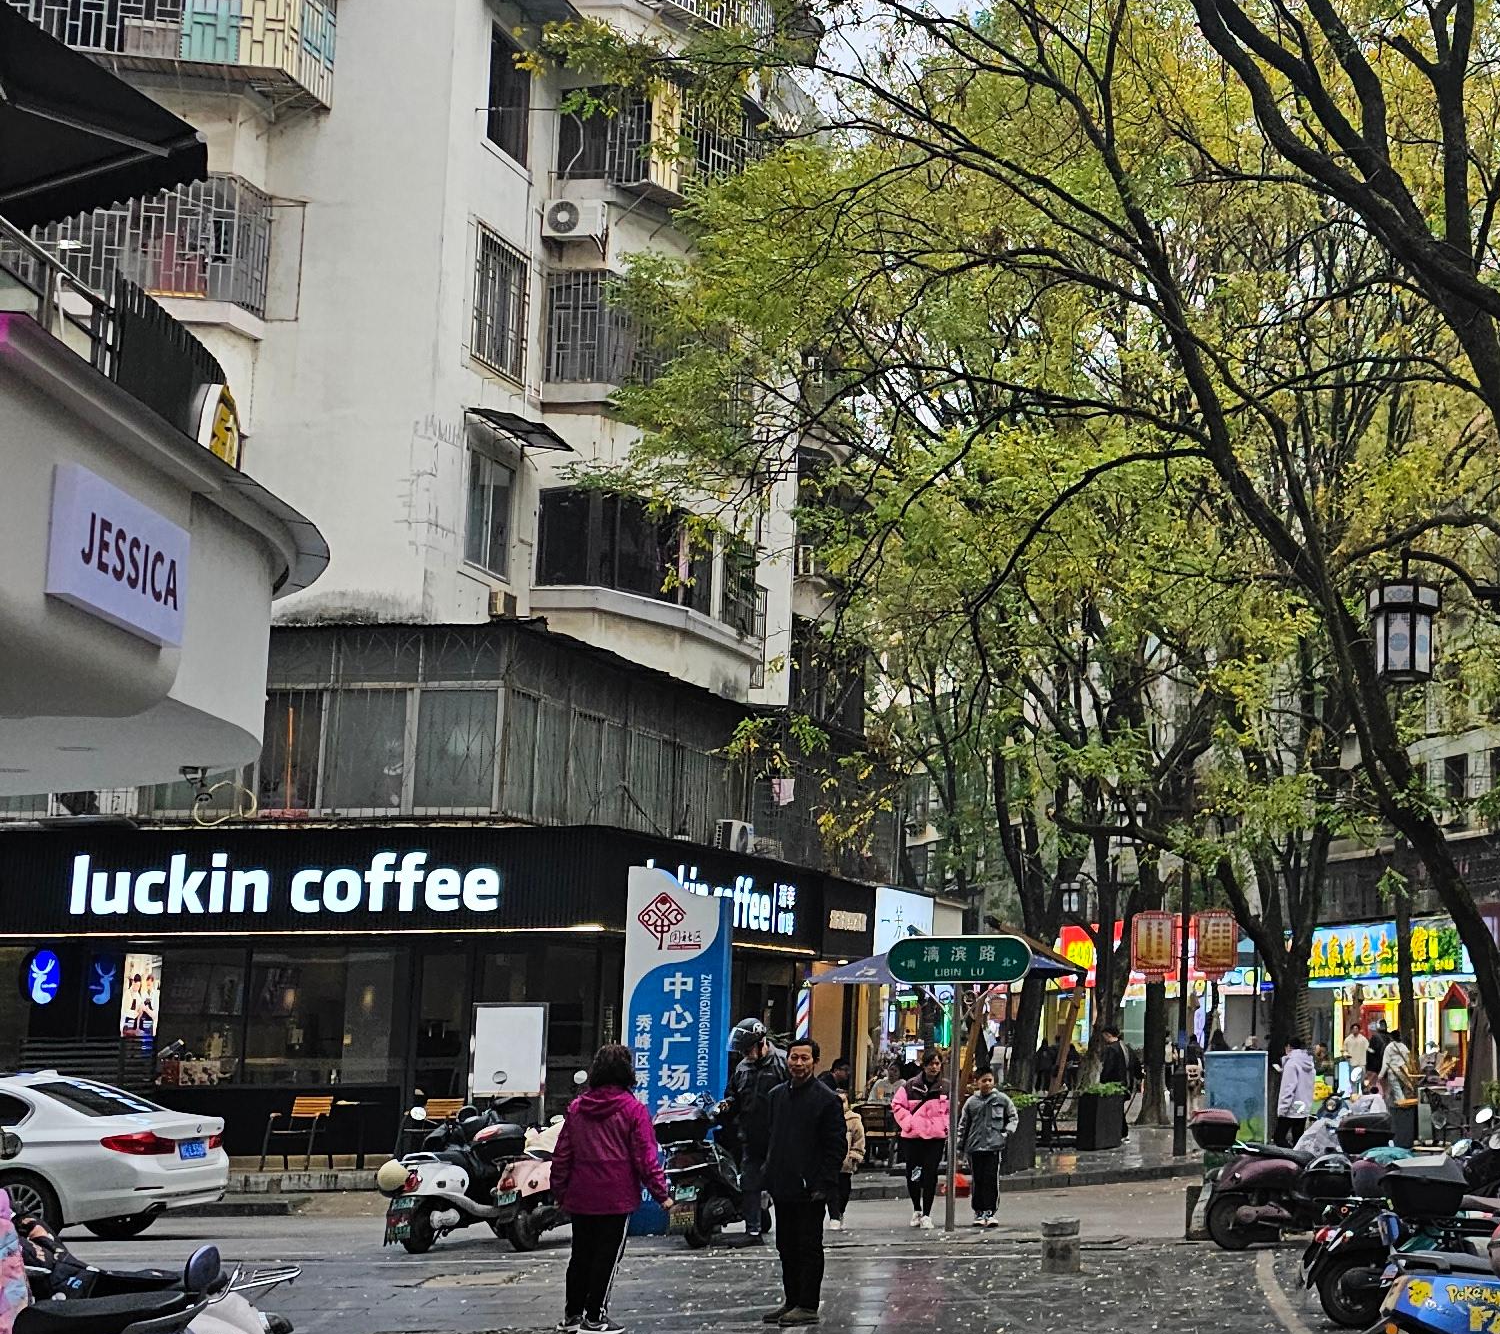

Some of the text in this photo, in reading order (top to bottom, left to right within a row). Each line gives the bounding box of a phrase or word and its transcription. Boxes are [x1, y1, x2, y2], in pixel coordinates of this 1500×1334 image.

[81, 512, 179, 611] JESSICA
[69, 851, 500, 914] luckin coffee
[923, 945, 996, 963] 漓滨路
[1002, 957, 1012, 967] 北
[934, 967, 985, 977] LIBIN LU
